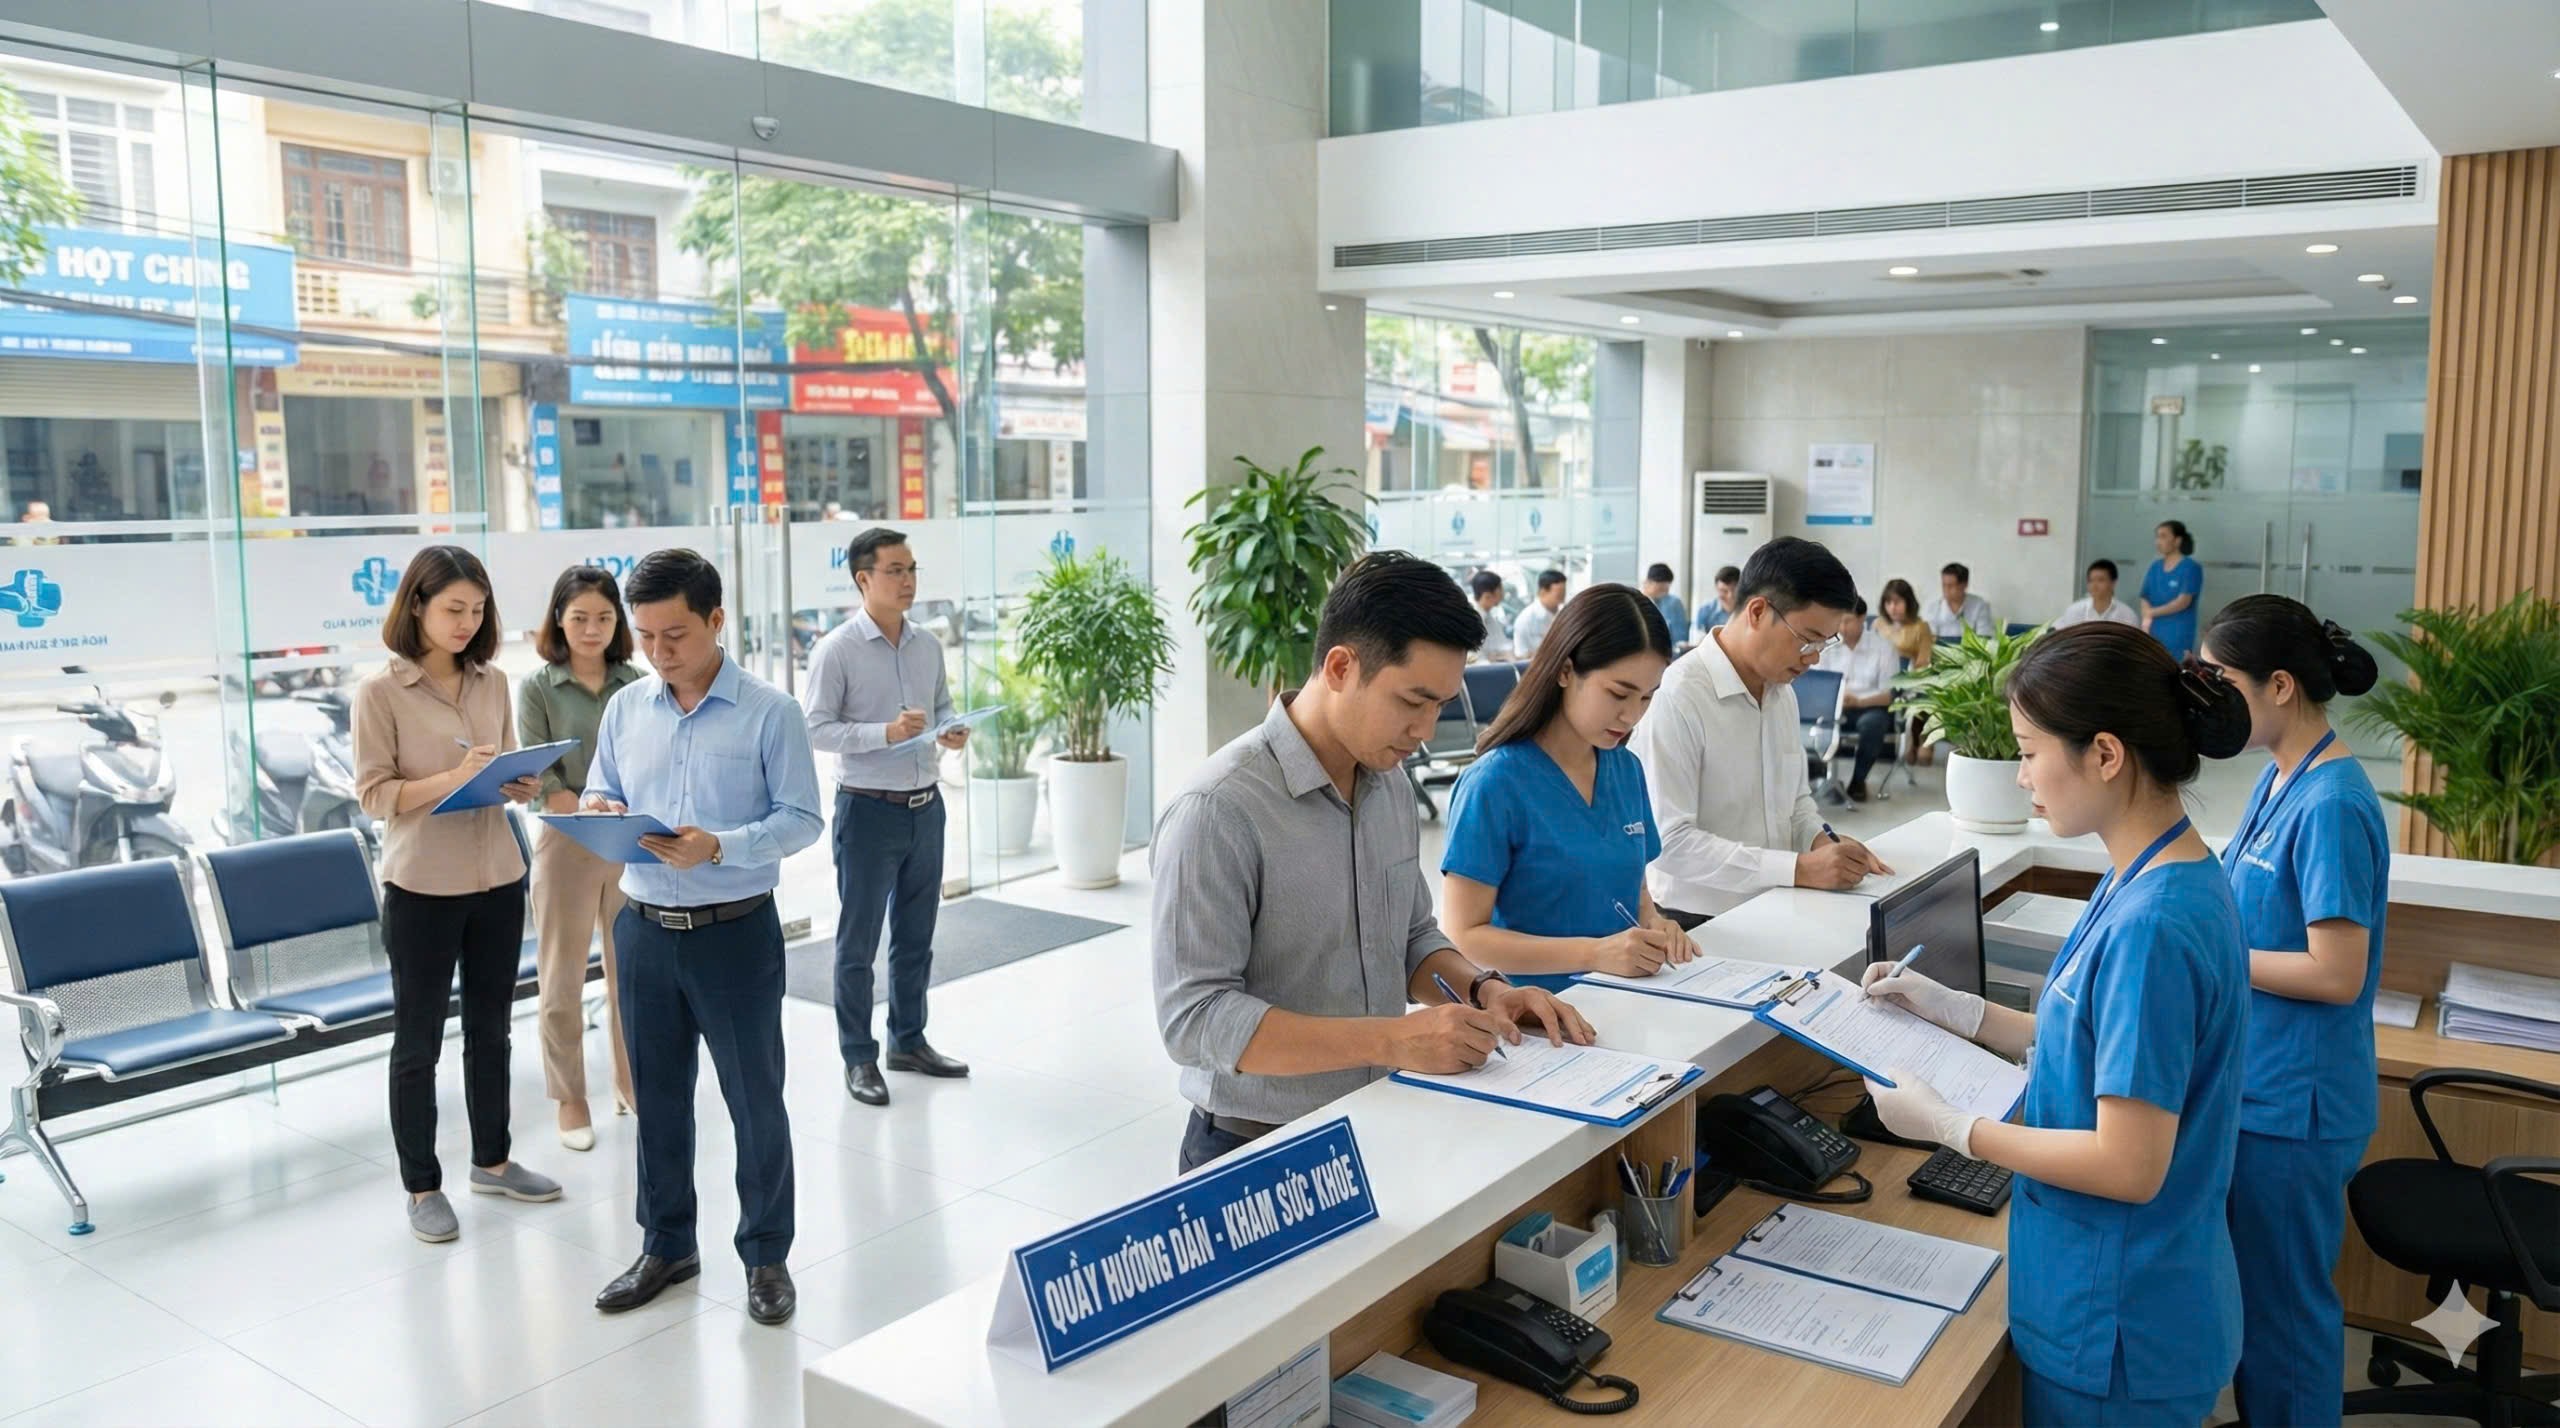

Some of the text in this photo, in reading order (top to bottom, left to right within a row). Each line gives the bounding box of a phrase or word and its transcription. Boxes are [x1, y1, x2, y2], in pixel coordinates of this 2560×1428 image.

[1044, 1143, 1360, 1335] QUẦY HƯỚNG DẪN - KHÁM SỨC KHỎE
